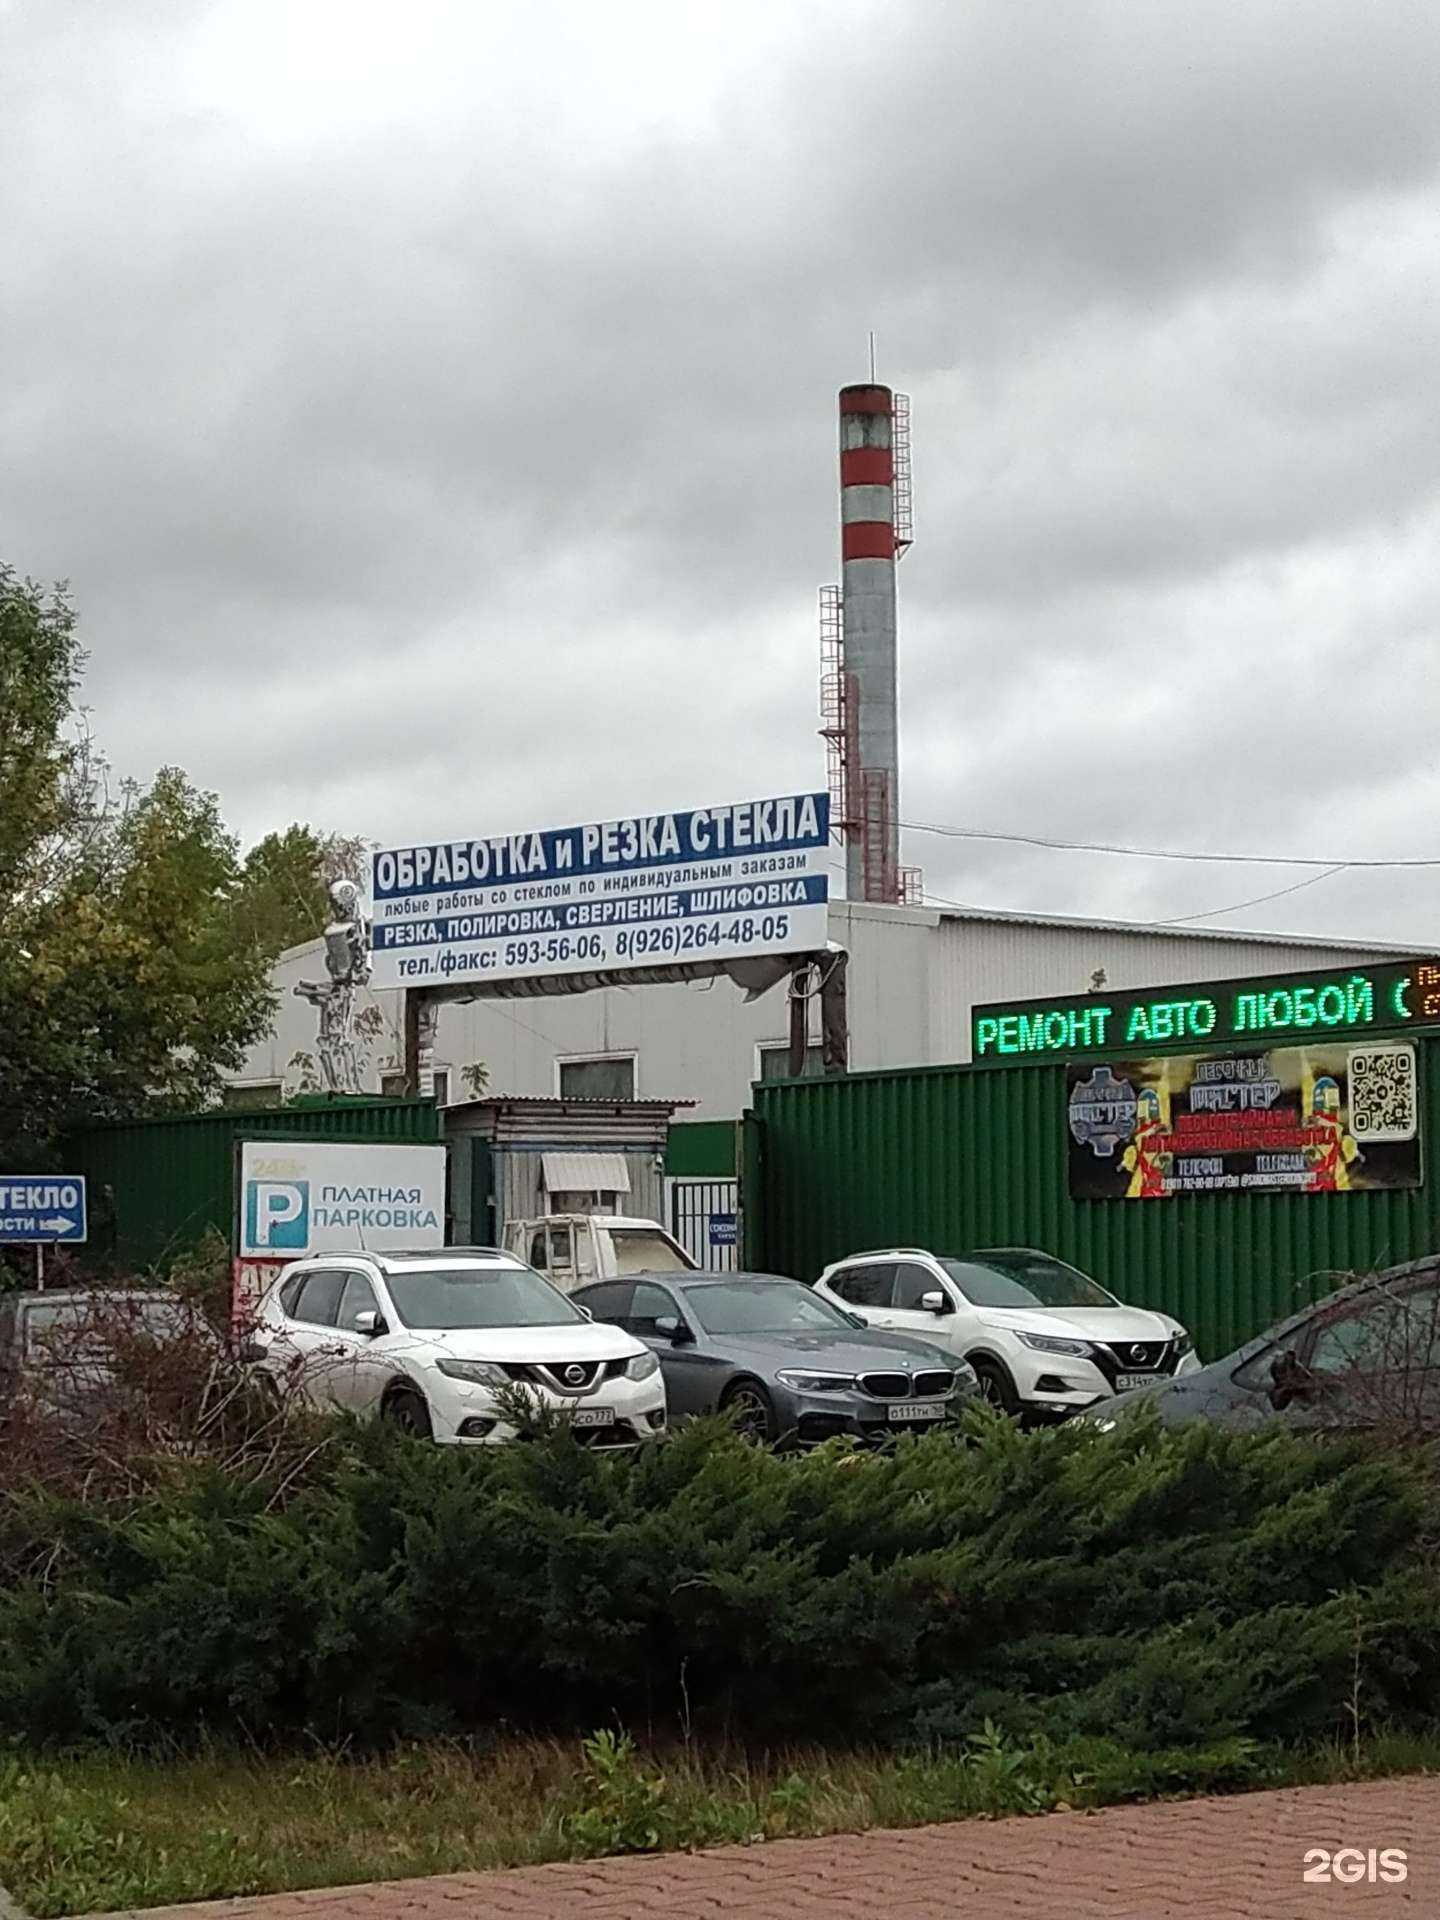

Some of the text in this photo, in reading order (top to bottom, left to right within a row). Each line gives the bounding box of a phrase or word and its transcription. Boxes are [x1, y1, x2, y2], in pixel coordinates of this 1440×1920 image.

[376, 795, 820, 891] ОБРАБОТКА и РЕЗКА СТЕКЛА
[384, 853, 807, 917] любые работы со стеклом по индивидуальным заказам
[384, 880, 808, 946] РЕЗКА, ПОЛИРОВКА, СВЕРЛЕНИЕ, ШЛИФОВКА
[398, 914, 789, 978] тел./факс: 593-56-06, 8(926)264-48-05
[977, 1007, 1112, 1055] РЕМОНТ
[1126, 999, 1217, 1042] АВТО
[1233, 976, 1374, 1032] ЛЮБОЙ
[312, 1208, 438, 1229] ПАРКОВКА
[321, 1186, 422, 1204] ПЛАТНАЯ
